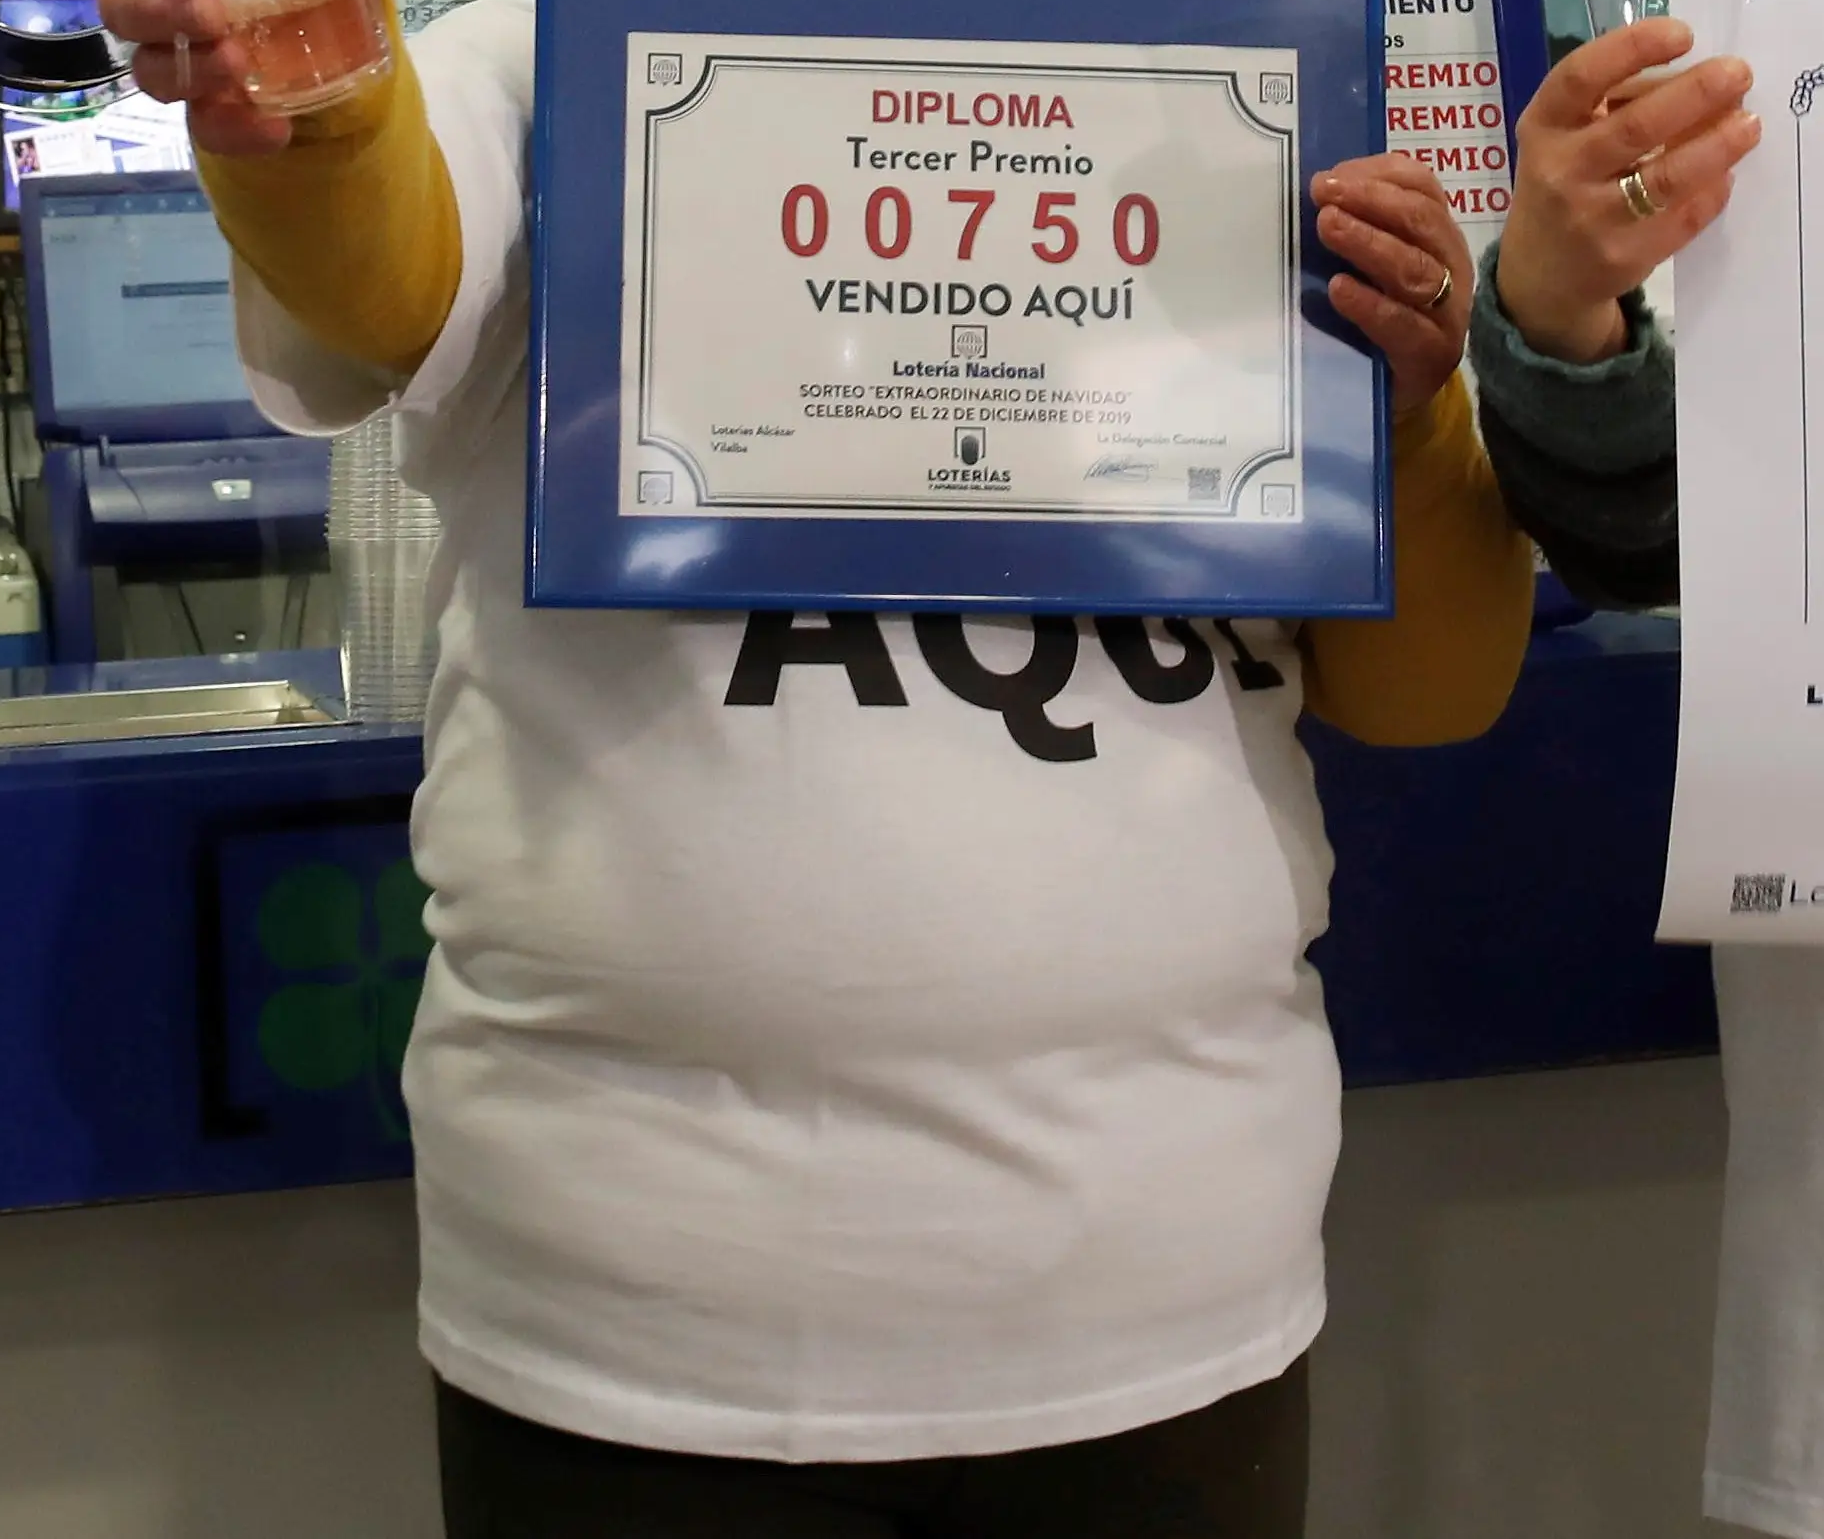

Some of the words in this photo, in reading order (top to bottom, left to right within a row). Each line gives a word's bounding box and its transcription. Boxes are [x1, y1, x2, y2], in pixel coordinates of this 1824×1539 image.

[872, 89, 1075, 129] DIPLOMA
[847, 136, 957, 172] Tercer
[970, 139, 1094, 176] Premio
[805, 279, 1013, 317] VENDIDO
[1023, 276, 1135, 327] AQUÍ
[892, 359, 961, 380] Lotería
[965, 361, 1046, 380] Nacional
[799, 384, 866, 400] SORTEO
[1025, 388, 1048, 404] DE
[804, 404, 903, 420] CELEBRADO
[909, 406, 931, 421] EL
[932, 406, 952, 421] 22
[953, 406, 977, 422] DE
[979, 407, 1069, 424] DICIEMBRE
[1073, 409, 1096, 425] DE
[1098, 410, 1132, 426] 2019
[927, 466, 1012, 483] LOTERÍAS
